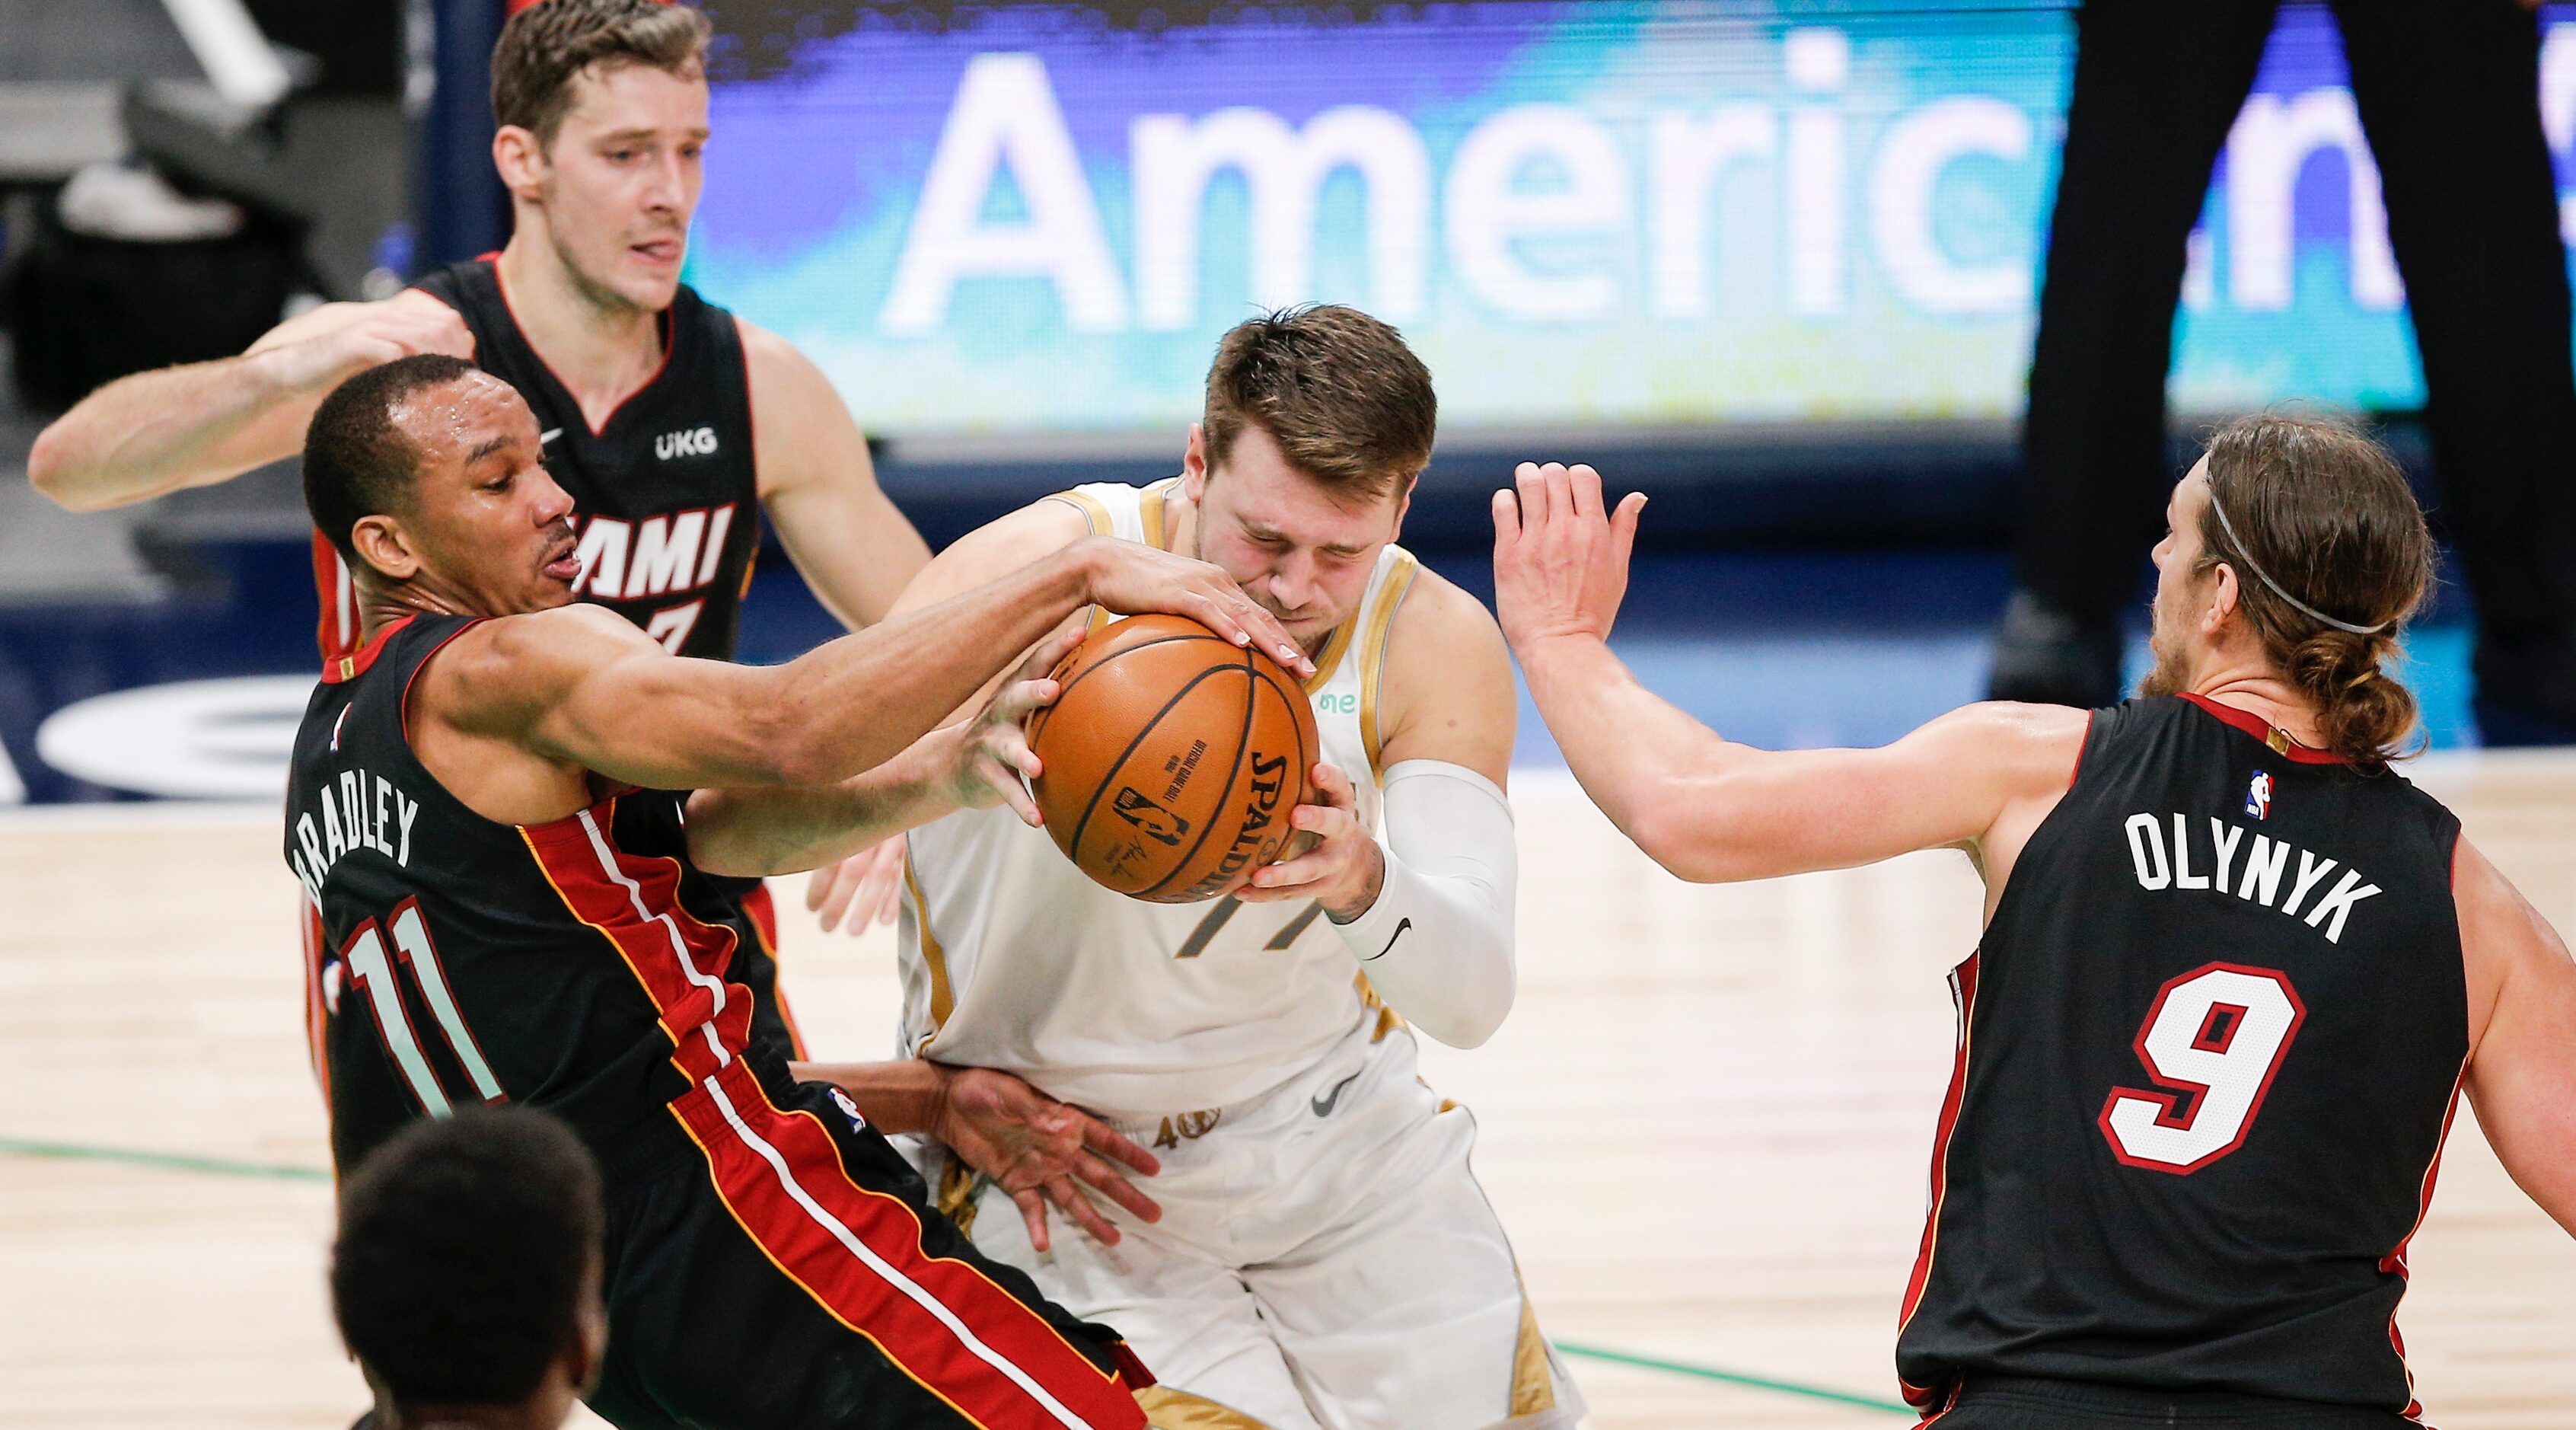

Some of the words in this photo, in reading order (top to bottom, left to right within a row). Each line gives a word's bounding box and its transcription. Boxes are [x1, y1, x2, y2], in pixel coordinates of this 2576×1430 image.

[881, 27, 2405, 332] Americn
[655, 426, 719, 461] UKG
[566, 502, 738, 603] AMI
[292, 768, 419, 918] BRADLEY
[2124, 812, 2384, 945] OLYNYK
[339, 894, 511, 1119] 11
[2096, 960, 2308, 1176] 9
